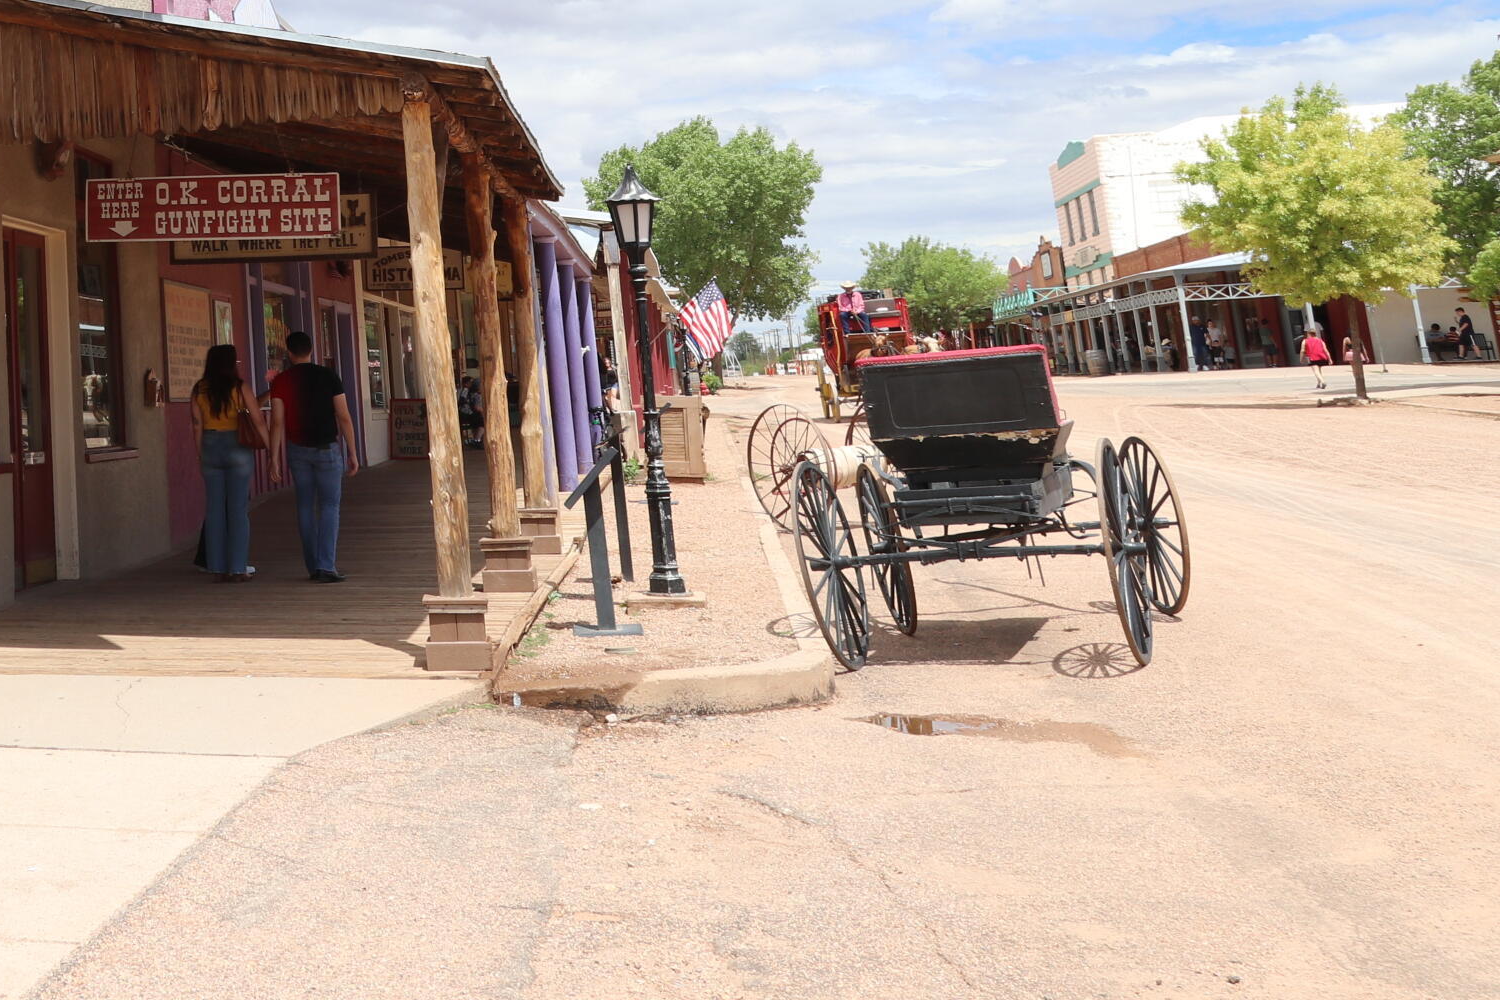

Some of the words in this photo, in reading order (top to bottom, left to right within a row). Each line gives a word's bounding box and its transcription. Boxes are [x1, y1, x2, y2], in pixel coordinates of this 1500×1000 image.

[97, 182, 143, 200] ENTER
[155, 181, 208, 206] O.K.
[101, 201, 140, 219] HERE
[155, 209, 271, 235] GUNFIGHT
[280, 207, 332, 233] SITE
